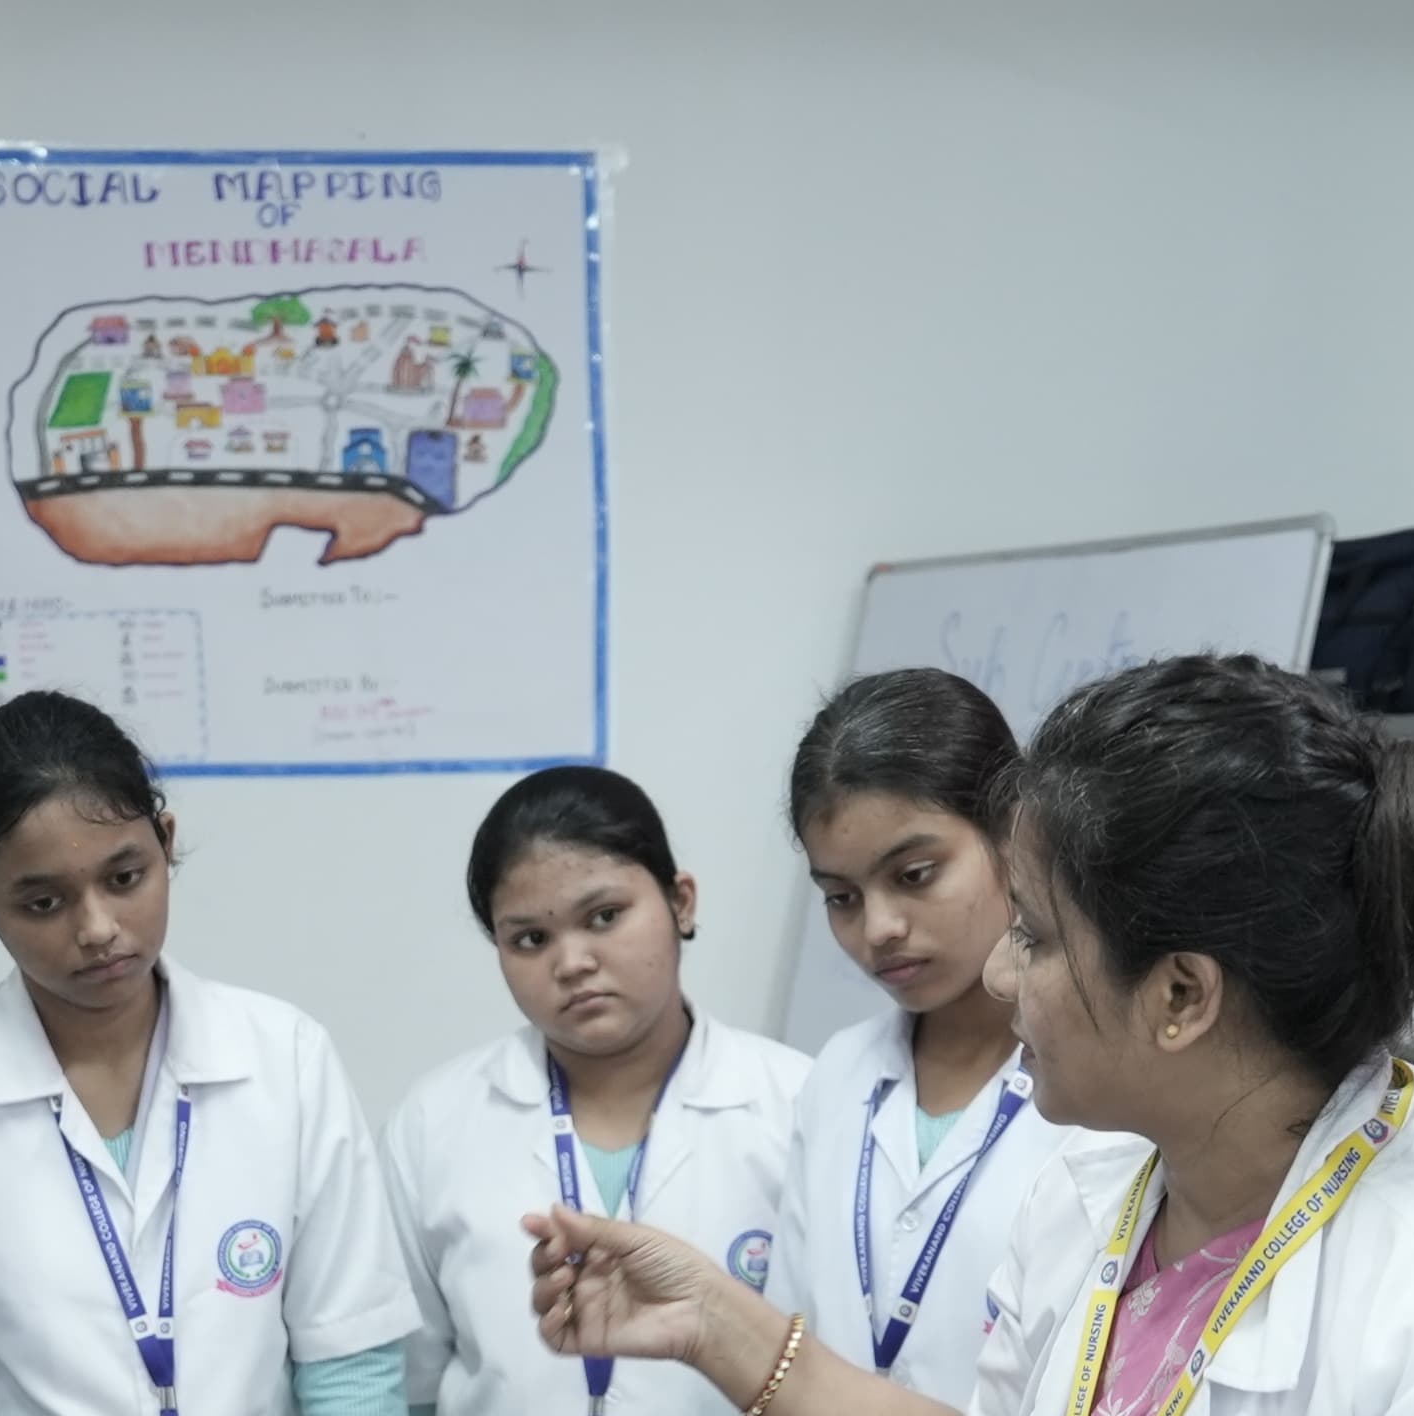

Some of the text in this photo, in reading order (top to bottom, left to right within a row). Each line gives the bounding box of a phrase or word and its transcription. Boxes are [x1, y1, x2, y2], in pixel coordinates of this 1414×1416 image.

[212, 169, 442, 202] MAPPING
[255, 201, 301, 229] OF
[87, 1194, 111, 1242] COLLEGE
[1211, 1147, 1361, 1334] VIVEKANAND COLLEGE OF NURSING
[106, 1243, 138, 1311] VIVEKANAND
[910, 1222, 947, 1294] VIVEKANAND
[1085, 1303, 1106, 1361] NURSING
[1081, 1365, 1092, 1382] OF
